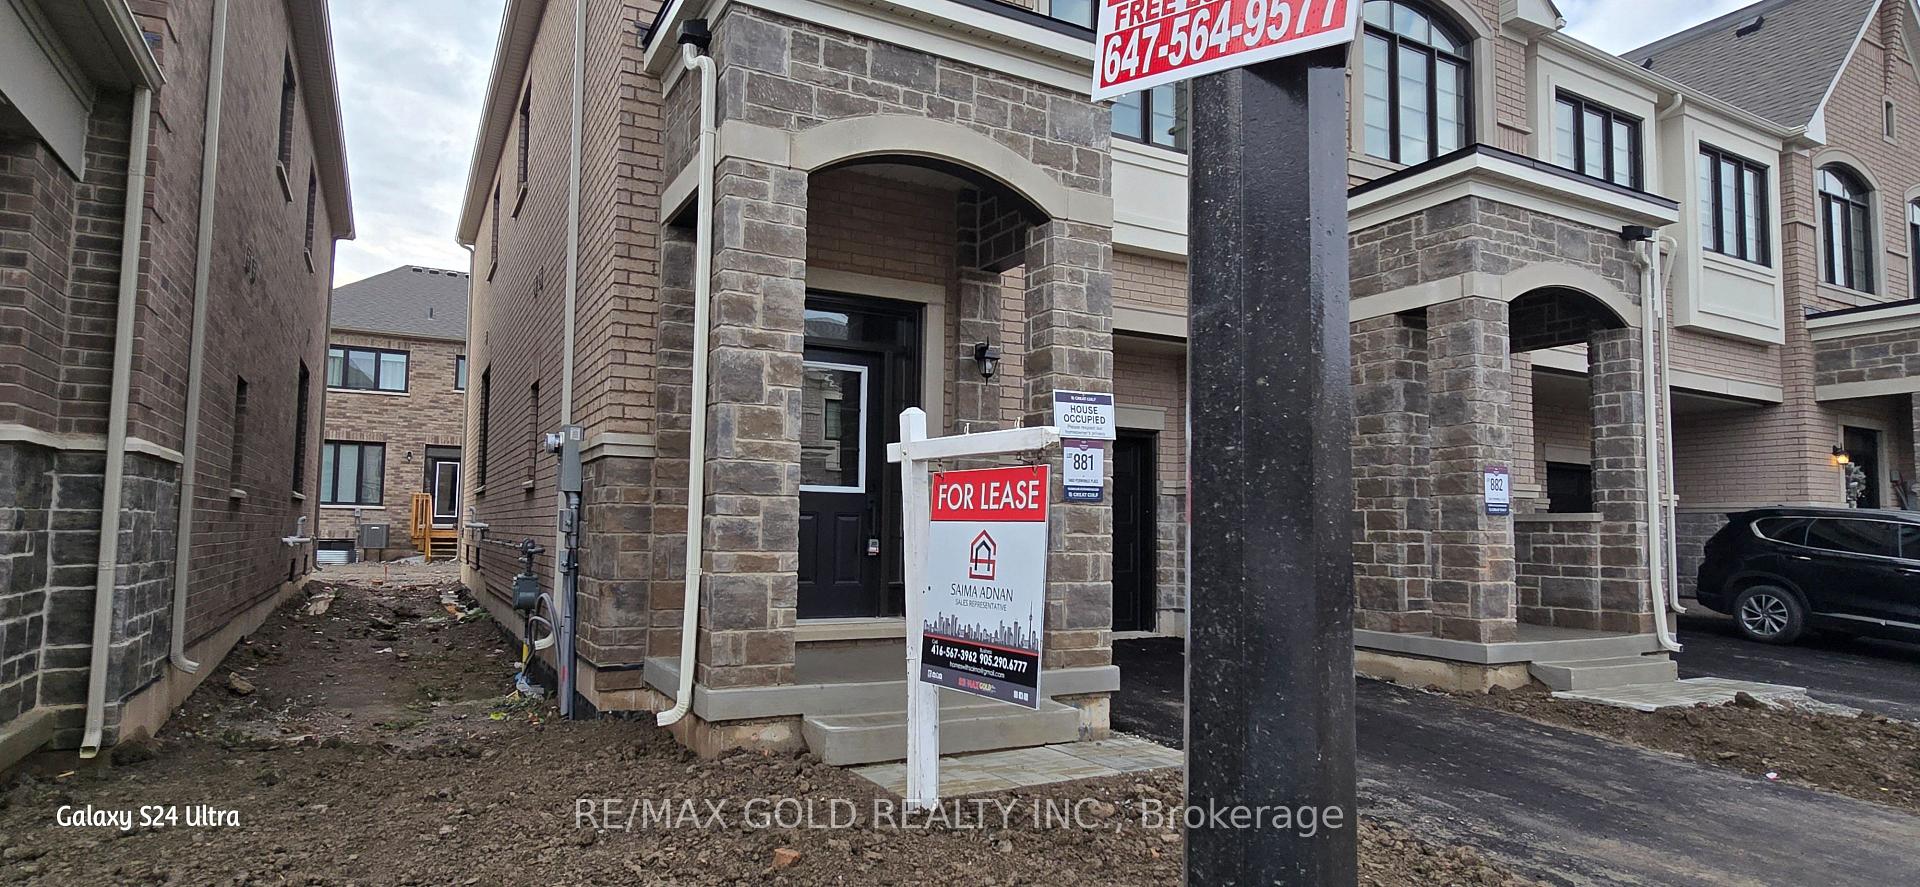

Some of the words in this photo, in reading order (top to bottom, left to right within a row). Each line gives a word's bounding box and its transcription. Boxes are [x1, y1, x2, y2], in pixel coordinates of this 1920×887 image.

[1115, 0, 1176, 30] FREE
[1104, 0, 1337, 83] 647-564-9577
[1070, 404, 1098, 414] HOUSE
[1063, 413, 1106, 425] OCCUPIED
[1073, 453, 1094, 471] 881
[1490, 478, 1503, 492] 882
[937, 482, 974, 511] FOR
[980, 480, 1040, 510] LEASE
[950, 583, 978, 598] SAIMA
[979, 586, 1014, 603] ADNAN
[954, 598, 969, 607] SALES
[969, 599, 1007, 612] REPRESENTATIVE
[930, 644, 978, 663] 416-567-3962
[979, 653, 1028, 673] 905.290.6777
